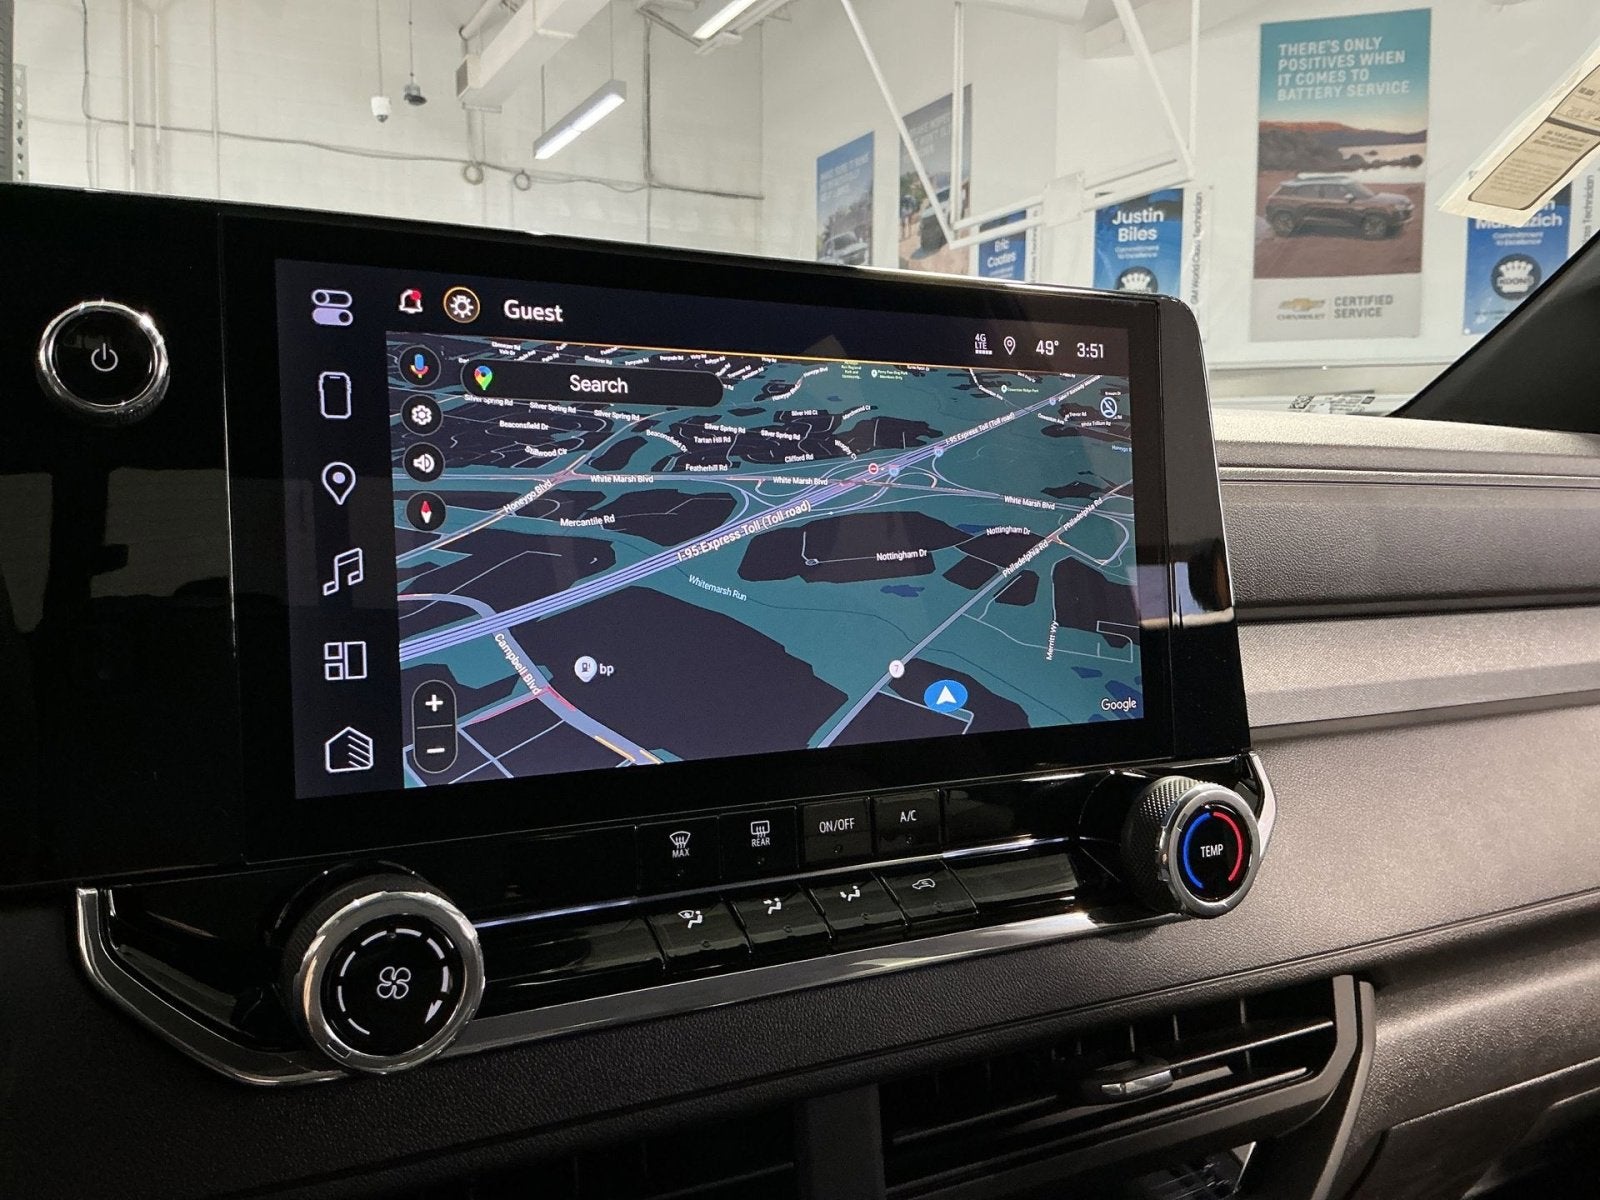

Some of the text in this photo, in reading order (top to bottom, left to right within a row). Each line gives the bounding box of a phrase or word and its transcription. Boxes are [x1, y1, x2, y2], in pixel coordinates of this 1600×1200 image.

[1279, 36, 1383, 57] THERE'S ONLY
[1278, 50, 1405, 71] POSITIVES WHEN
[1278, 68, 1370, 87] IT COMES TO
[1277, 80, 1410, 101] BATTERY SERVICE
[1583, 174, 1594, 223] Technician
[1112, 207, 1164, 225] Justin
[1118, 227, 1158, 242] Biles
[1334, 295, 1393, 306] CERTIFIED
[503, 299, 564, 323] Guest
[1334, 307, 1382, 318] SERVICE
[975, 333, 986, 343] 4G
[975, 341, 987, 350] LTE
[1036, 339, 1059, 356] 49°
[1077, 343, 1104, 358] 3:51
[569, 374, 628, 394] Search
[529, 402, 576, 414] Silver Spring Rd
[593, 409, 640, 422] Silver Spring Rd
[500, 420, 549, 431] Beaconsfield Dr
[704, 422, 746, 434] Silver Spring Rd
[957, 426, 978, 441] Express
[978, 420, 989, 432] Toll
[646, 429, 682, 448] Beaconsfield
[694, 436, 731, 444] Tartan Hill Rd
[760, 429, 800, 441] Silver Spring Rd
[784, 453, 814, 463] Clifford Rd
[685, 463, 728, 472] Featherhill Rd
[590, 474, 654, 483] White Marsh Blvd
[773, 476, 828, 486] White Marsh Blvd
[503, 480, 552, 514] Honeygo Blvd
[1004, 495, 1055, 510] White Marsh Blvd
[560, 514, 615, 527] Mercantile Rd
[1063, 497, 1103, 532] Philadelphia Rd
[676, 499, 812, 563] I-95 Express Toll (Toll road)
[986, 525, 1030, 536] Nottingham Dr
[876, 548, 928, 562] Nottingham Dr
[1002, 540, 1048, 577] Philadelphia Rd
[688, 574, 748, 602] Whitemarsh Run
[1046, 620, 1059, 661] Merritt Wy
[494, 633, 541, 696] Campbell Blvd
[599, 663, 614, 676] bp
[1101, 698, 1137, 711] Google
[900, 809, 917, 823] A/C
[819, 817, 855, 833] ON/OFF
[751, 837, 771, 847] REAR
[671, 847, 690, 858] MAX
[1200, 843, 1224, 858] TEMP
